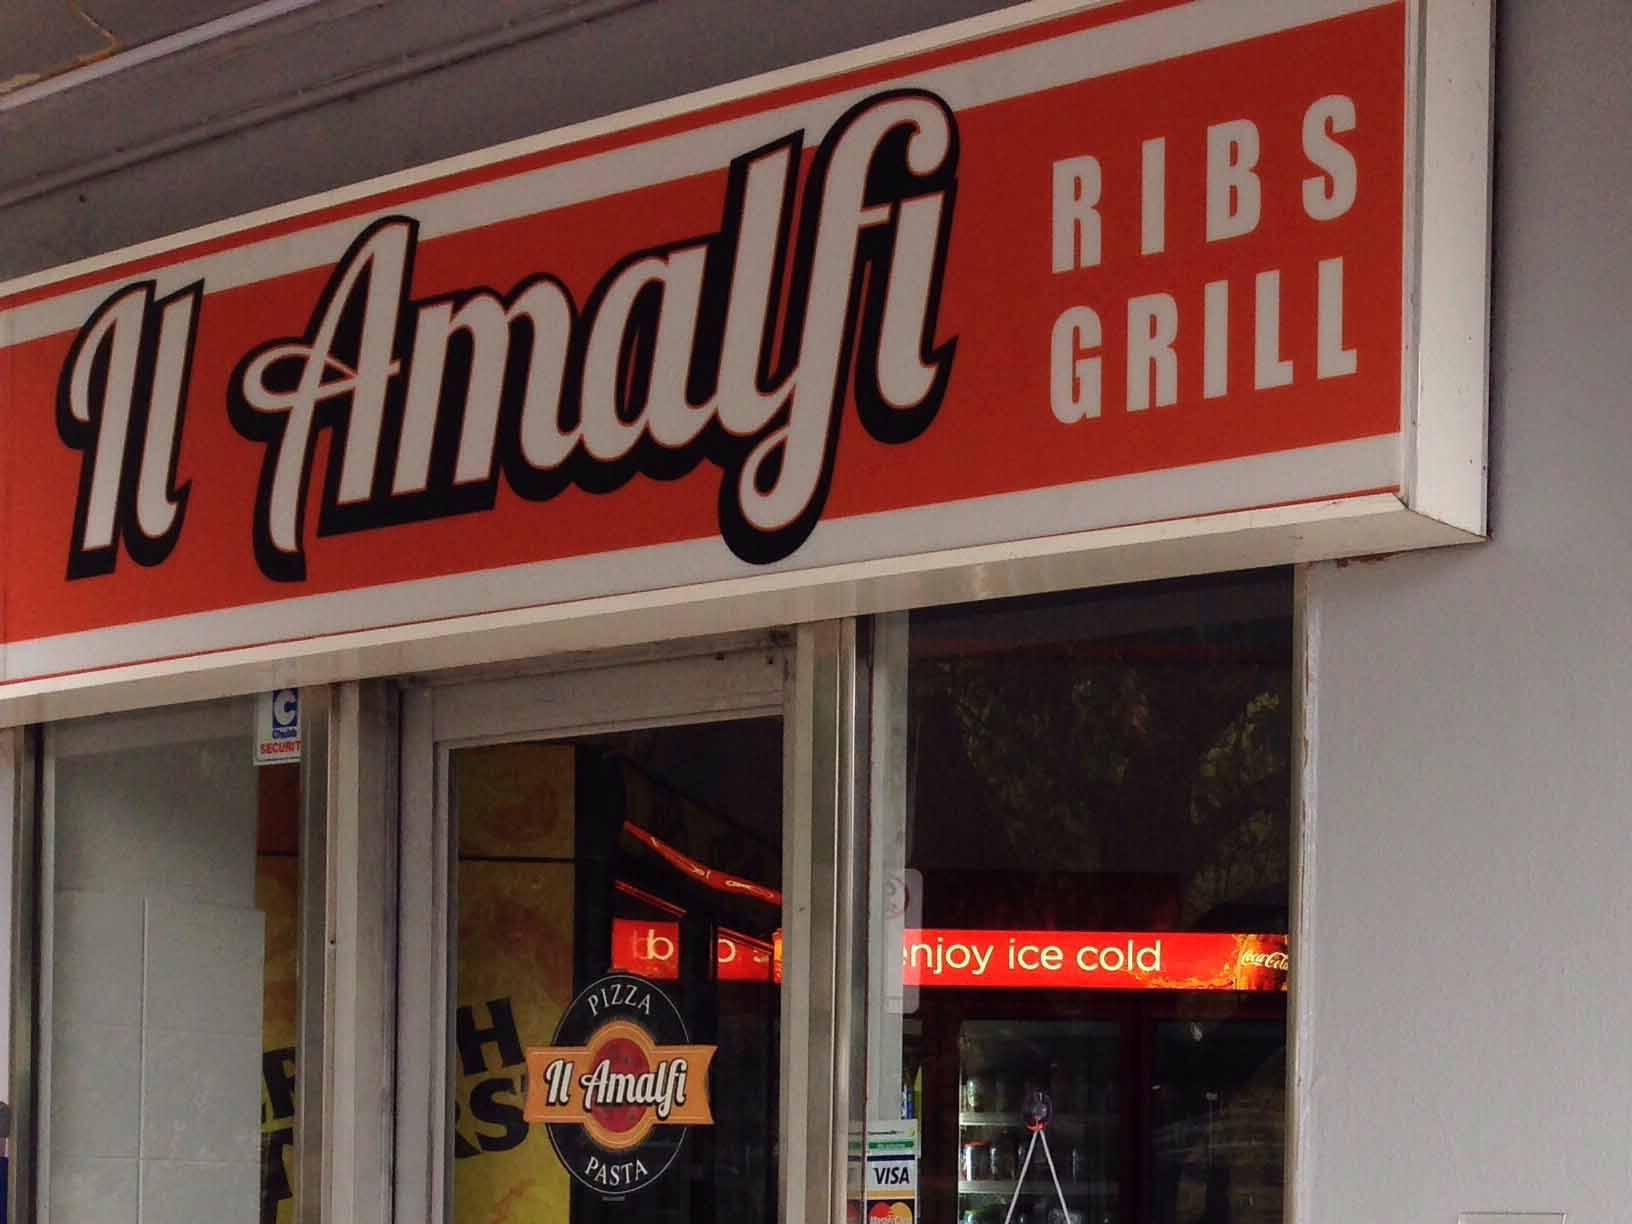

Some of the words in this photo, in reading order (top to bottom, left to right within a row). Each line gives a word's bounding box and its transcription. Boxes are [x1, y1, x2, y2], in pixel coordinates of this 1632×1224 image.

[1052, 95, 1358, 273] RIBS
[228, 88, 958, 580] Amalfi
[1050, 257, 1358, 425] GRILL
[261, 741, 301, 755] SECURIT
[1007, 938, 1063, 971] ice
[1077, 939, 1161, 972] cold
[588, 984, 650, 1016] PIZZA
[579, 1058, 689, 1119] Amalfi
[585, 1156, 648, 1186] PASTA
[874, 1167, 910, 1185] VISA
